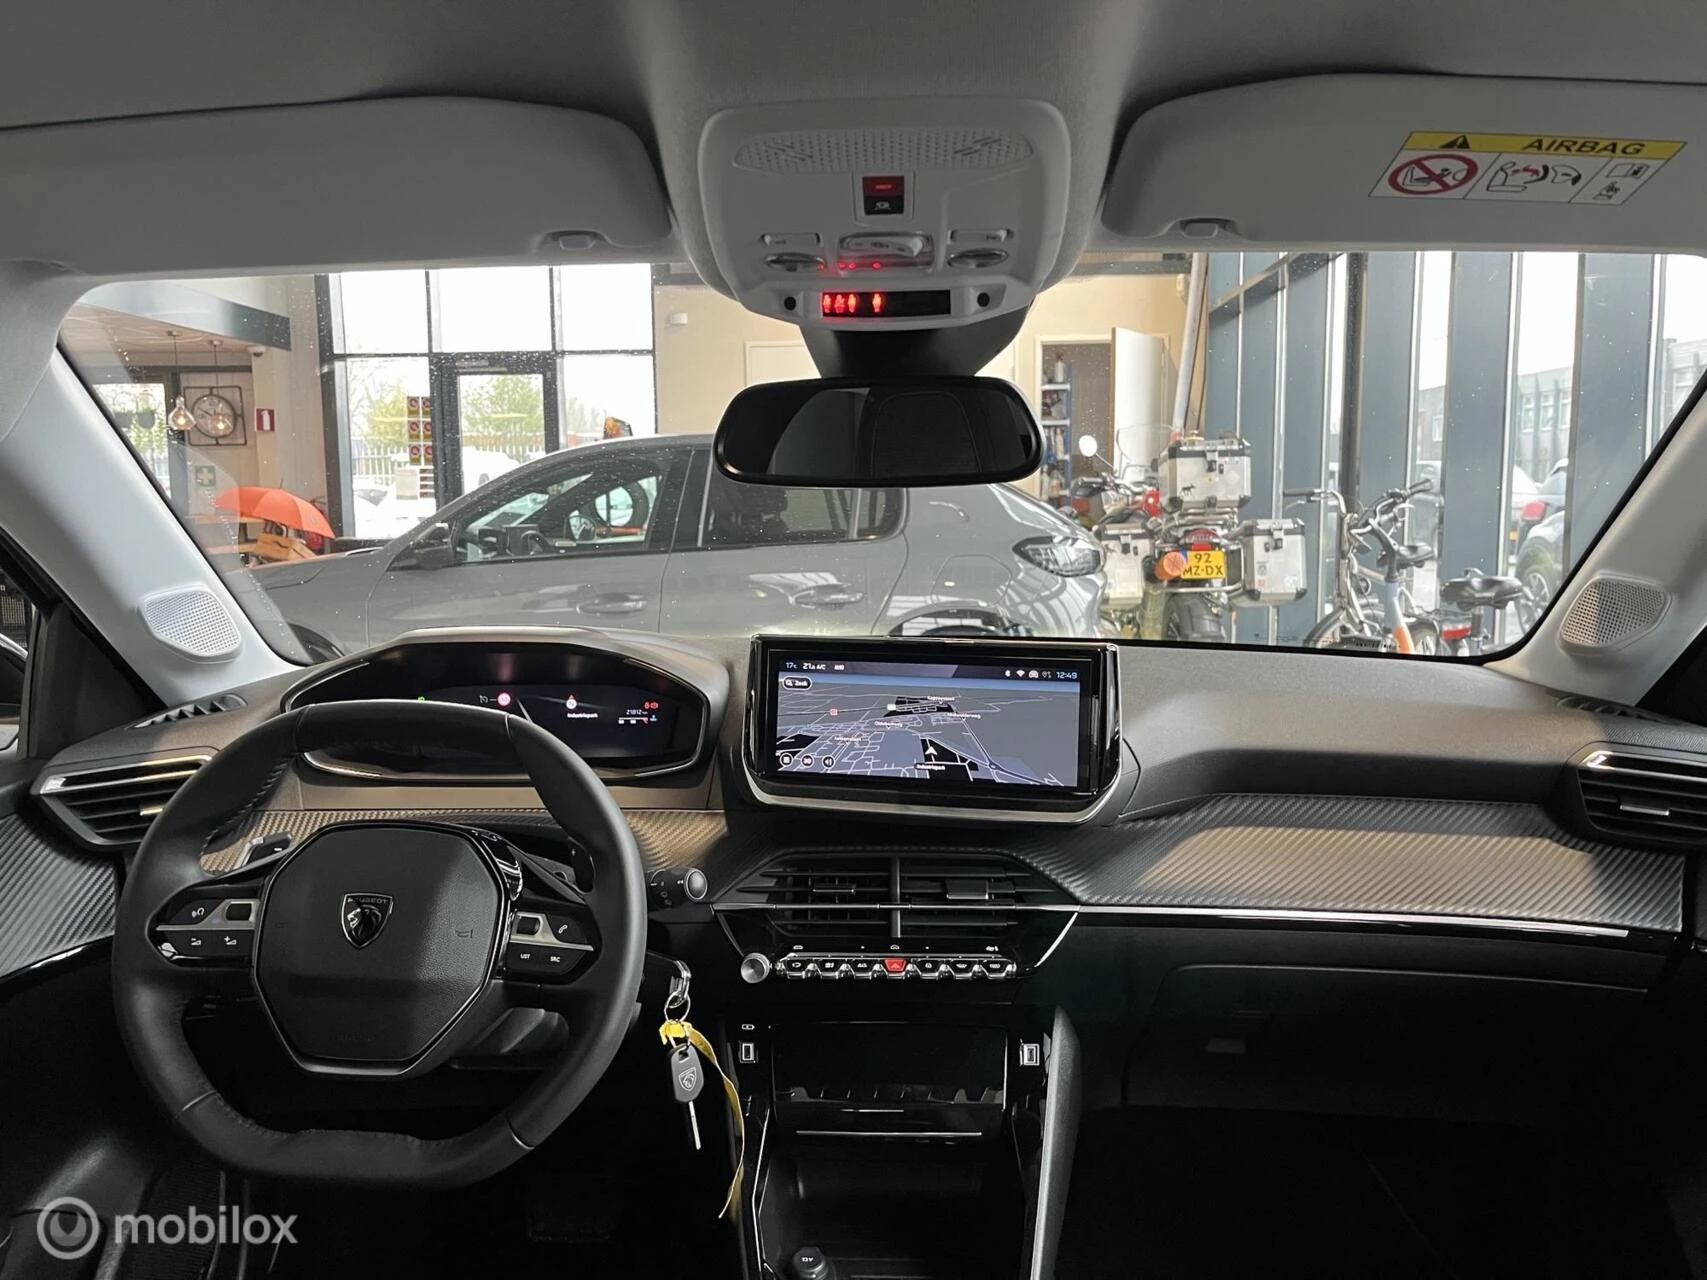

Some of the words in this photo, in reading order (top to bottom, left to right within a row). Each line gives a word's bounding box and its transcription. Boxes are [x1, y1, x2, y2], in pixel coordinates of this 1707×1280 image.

[1521, 138, 1646, 155] AIRBAG
[1194, 553, 1212, 563] 92
[1182, 565, 1224, 576] MZ-DX
[1056, 671, 1078, 679] 12:49
